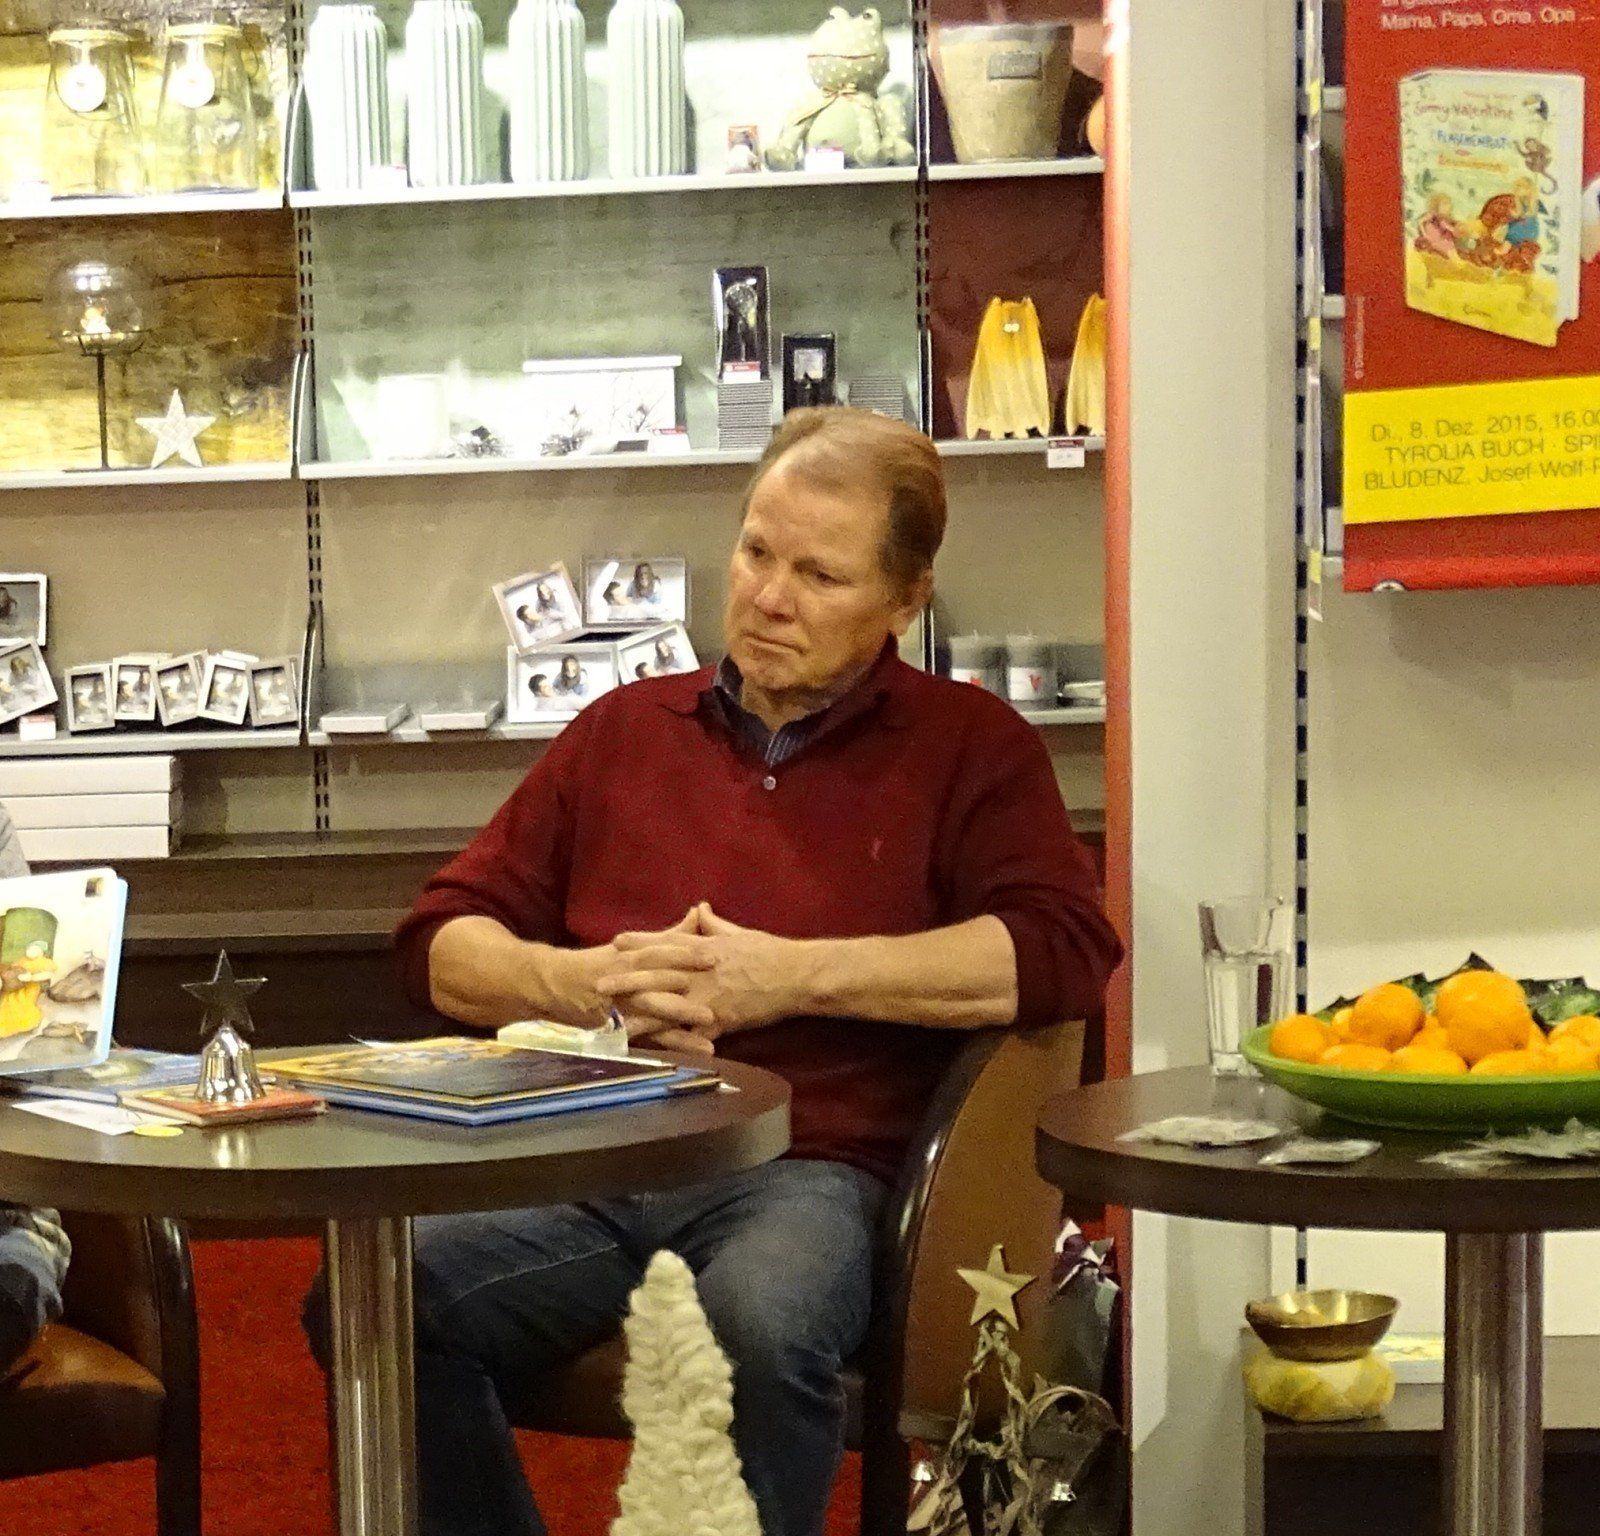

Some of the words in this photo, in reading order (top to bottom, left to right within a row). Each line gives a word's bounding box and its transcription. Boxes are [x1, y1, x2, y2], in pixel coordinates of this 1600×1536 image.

[1539, 7, 1576, 24] Opa
[1384, 443, 1475, 463] TYROLIA
[1481, 437, 1544, 458] BUCH
[1564, 434, 1600, 453] SPI
